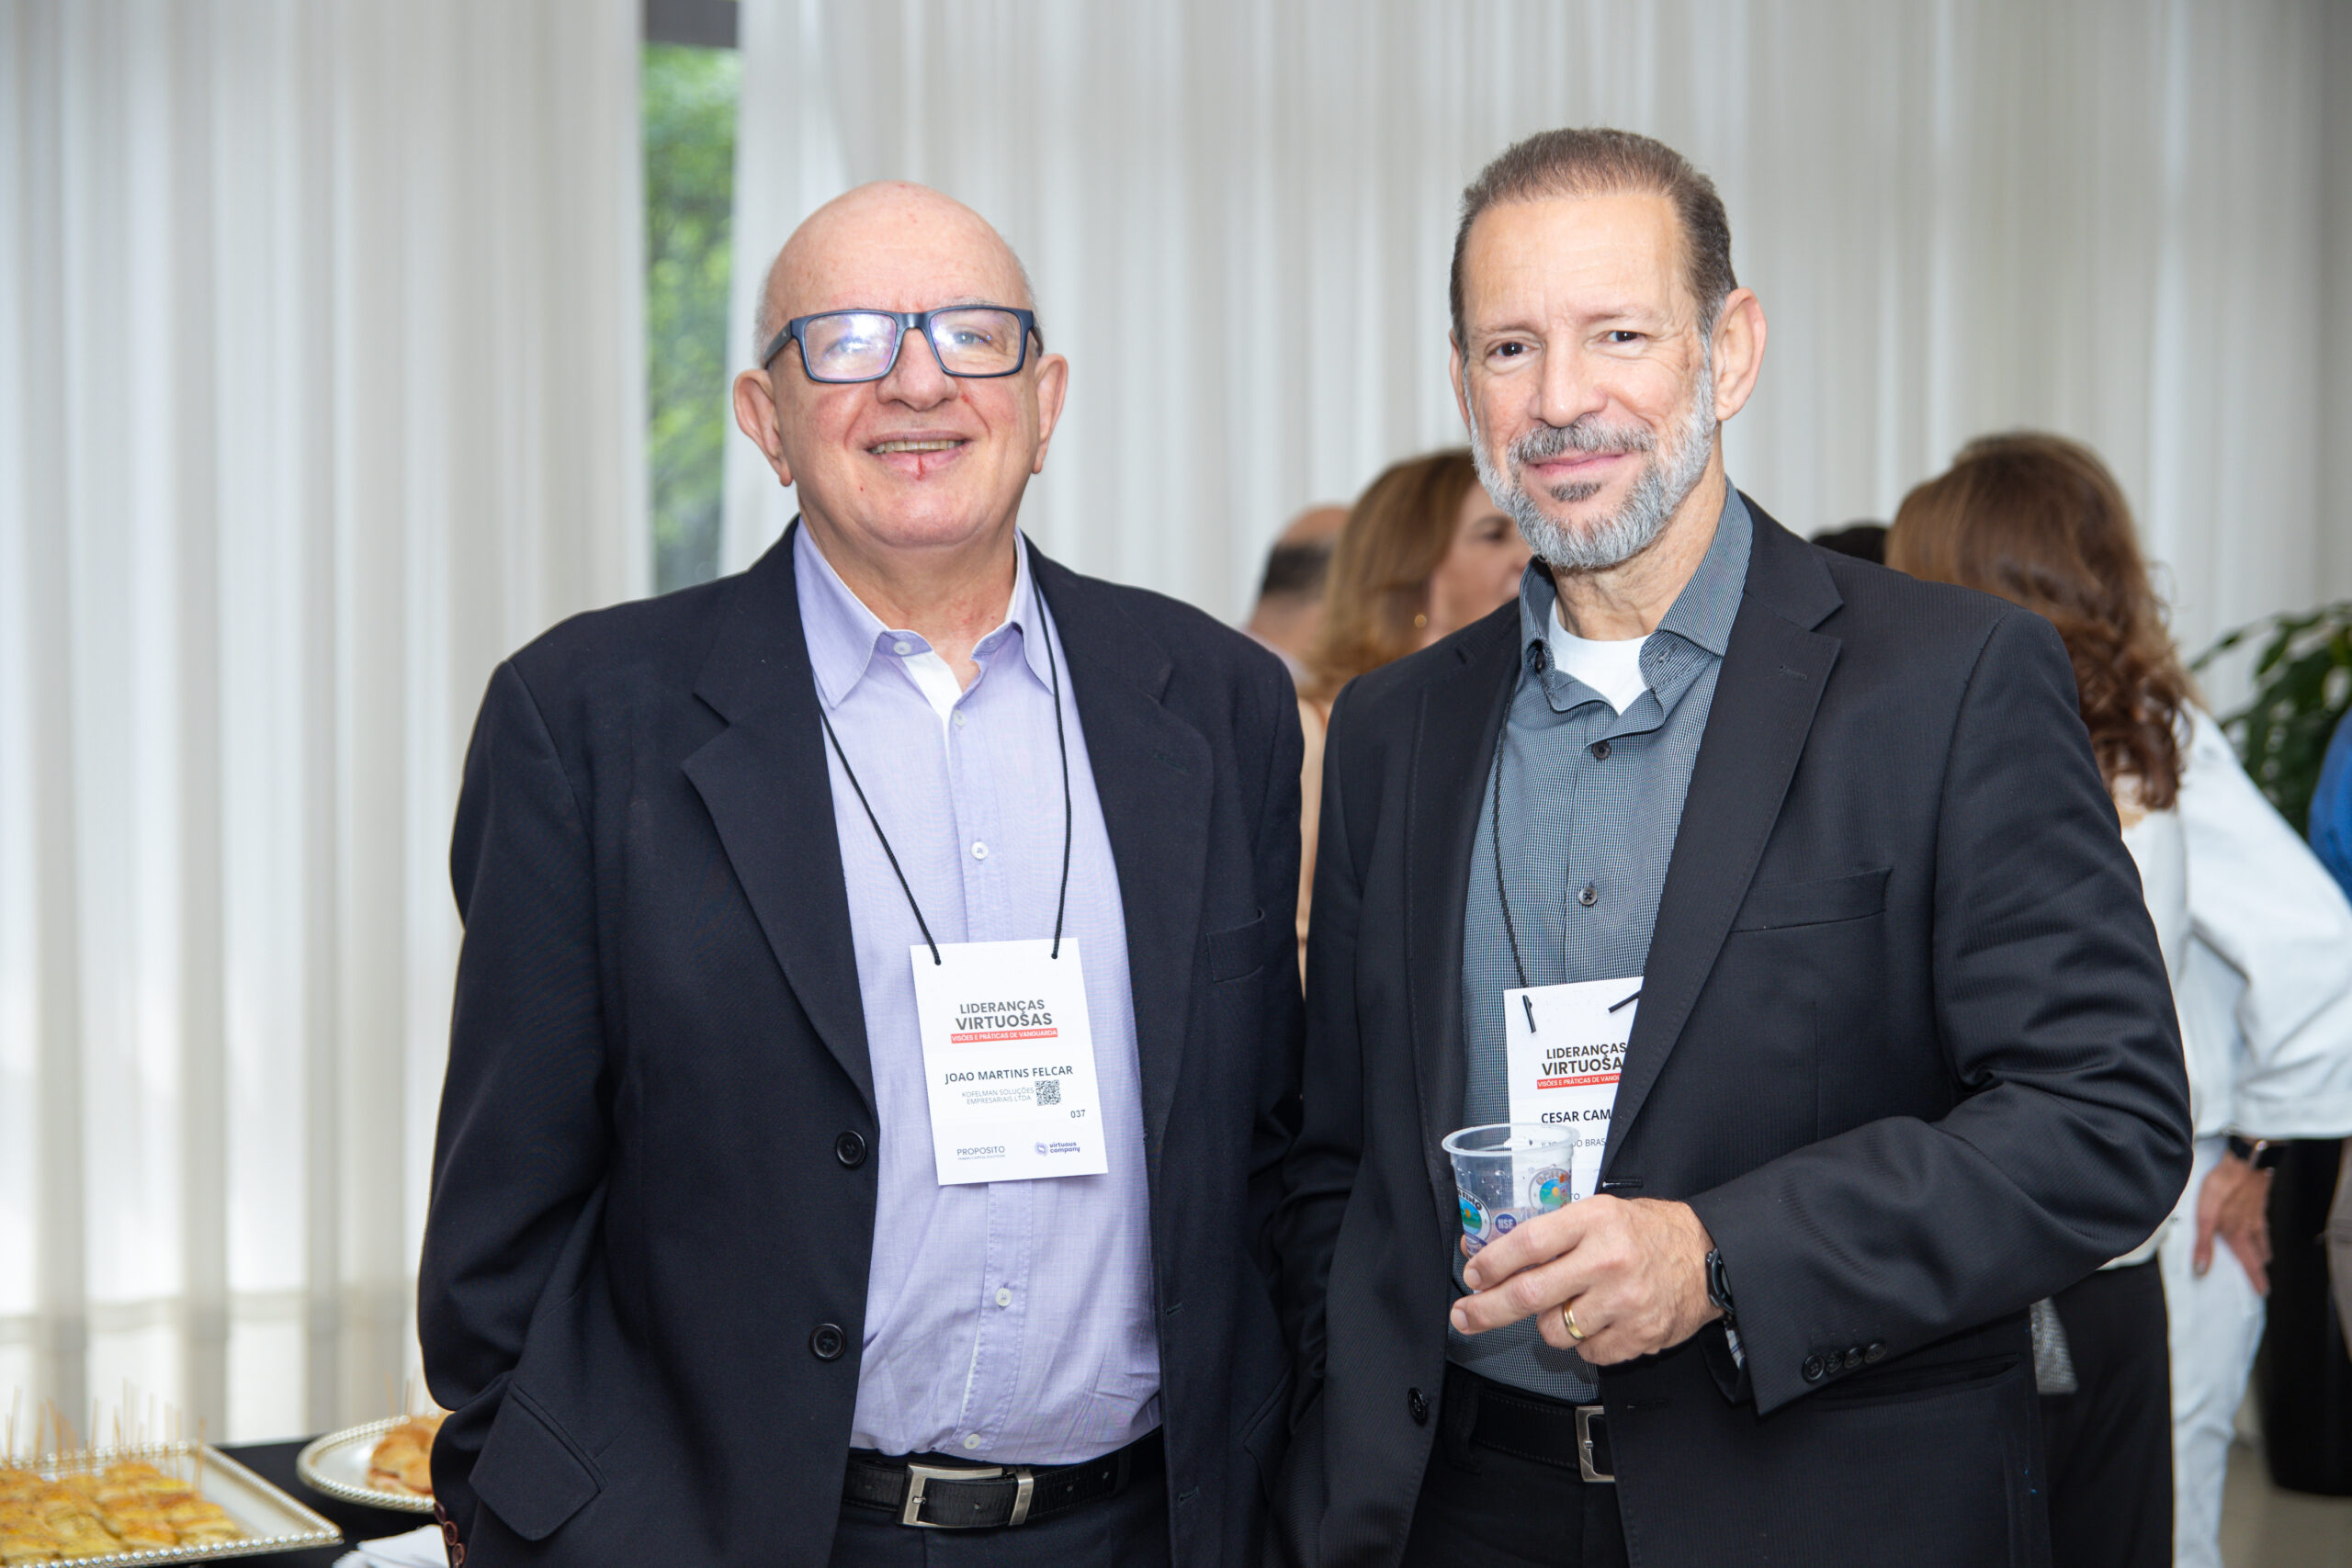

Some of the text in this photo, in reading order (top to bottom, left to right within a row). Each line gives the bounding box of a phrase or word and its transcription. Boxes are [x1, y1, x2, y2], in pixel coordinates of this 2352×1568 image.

[960, 999, 1045, 1014] LIDERANÇAS
[956, 1012, 1053, 1030] VIRTUOSAS
[952, 1032, 974, 1042] VISÕES
[979, 1032, 1009, 1040] PRÁTICAS
[1019, 1029, 1057, 1037] VANGUARDA
[1546, 1043, 1626, 1059] LIDERANÇAS
[1542, 1056, 1623, 1076] VIRTUOSA
[944, 1066, 1073, 1085] JOAO MARTINS FELCAR
[1537, 1078, 1558, 1088] VISÕES
[1563, 1076, 1591, 1085] PRÁTICAS
[1012, 1094, 1032, 1102] LTDA
[1070, 1110, 1086, 1118] 037
[1541, 1111, 1579, 1123] CESAR
[956, 1145, 1006, 1156] PROPOSITO
[1050, 1145, 1080, 1155] company
